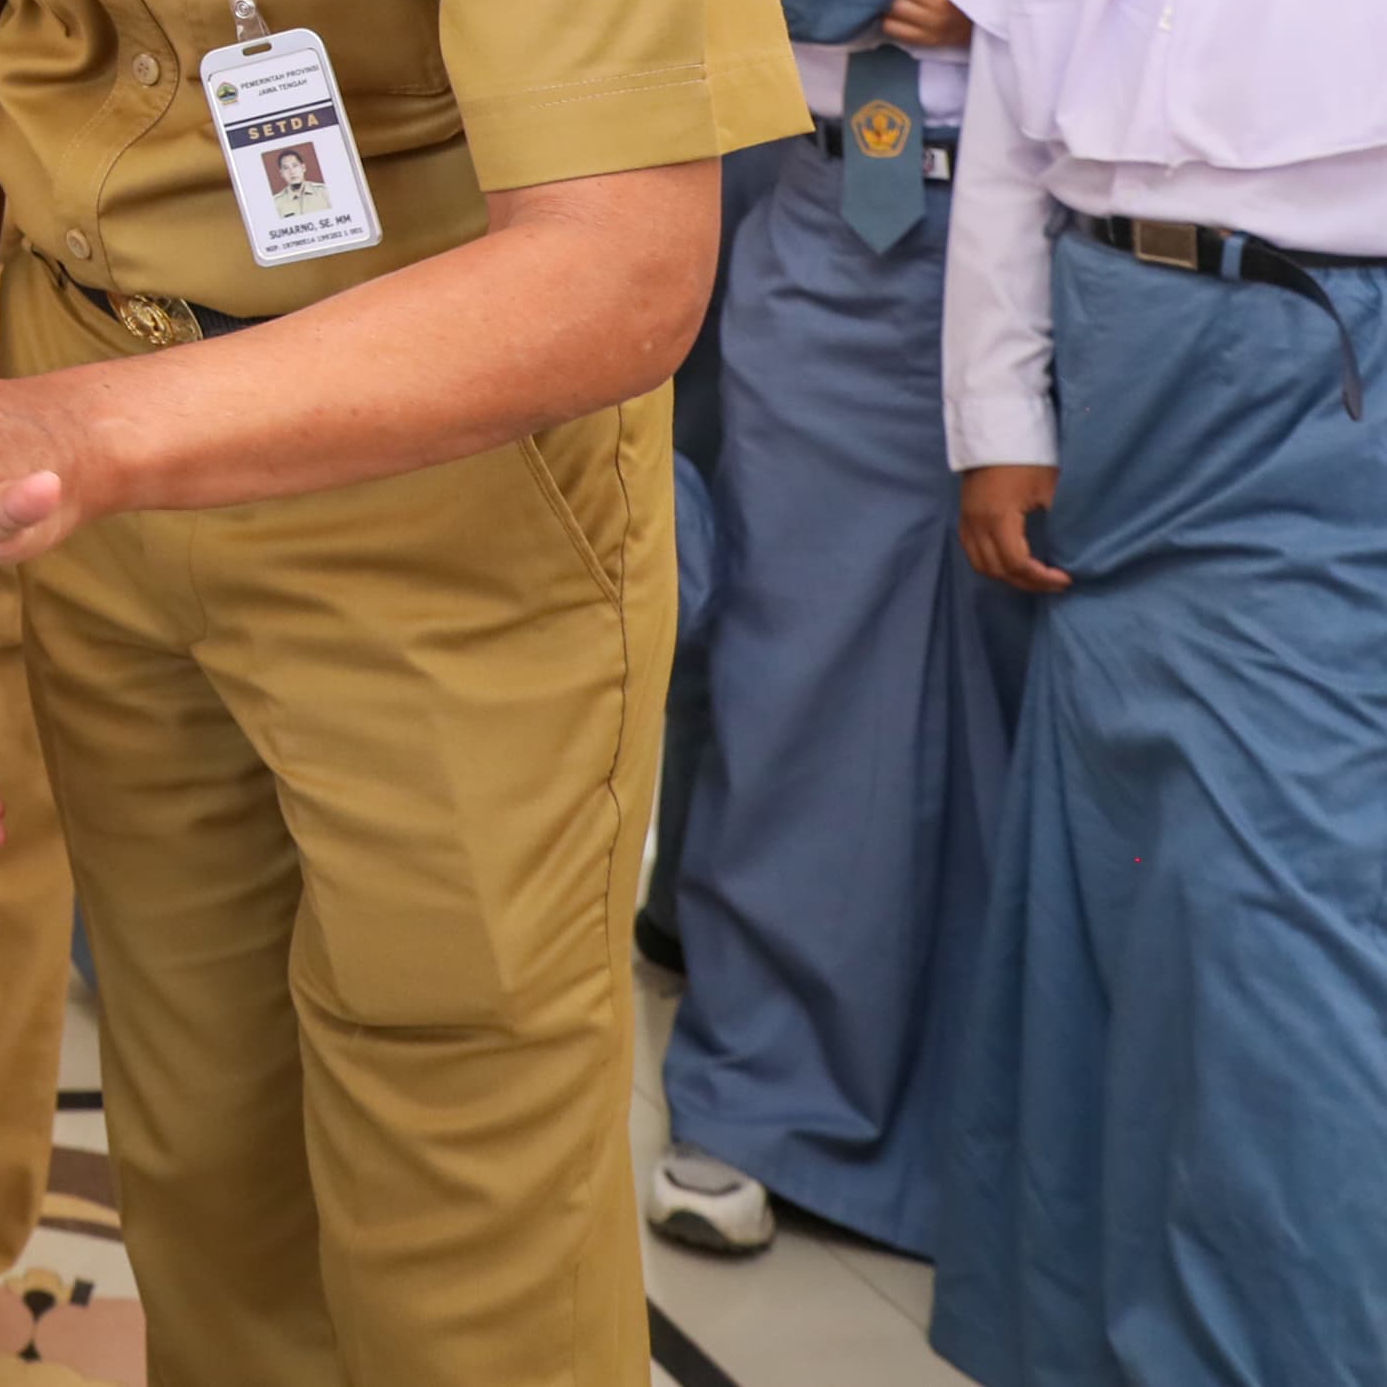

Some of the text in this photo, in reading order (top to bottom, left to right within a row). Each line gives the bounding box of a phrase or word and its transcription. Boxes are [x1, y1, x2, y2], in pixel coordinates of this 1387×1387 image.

[240, 64, 320, 90] PEMERINTAH PROVINSI
[258, 78, 308, 96] JAWA TENGAH
[247, 113, 319, 140] SETDA
